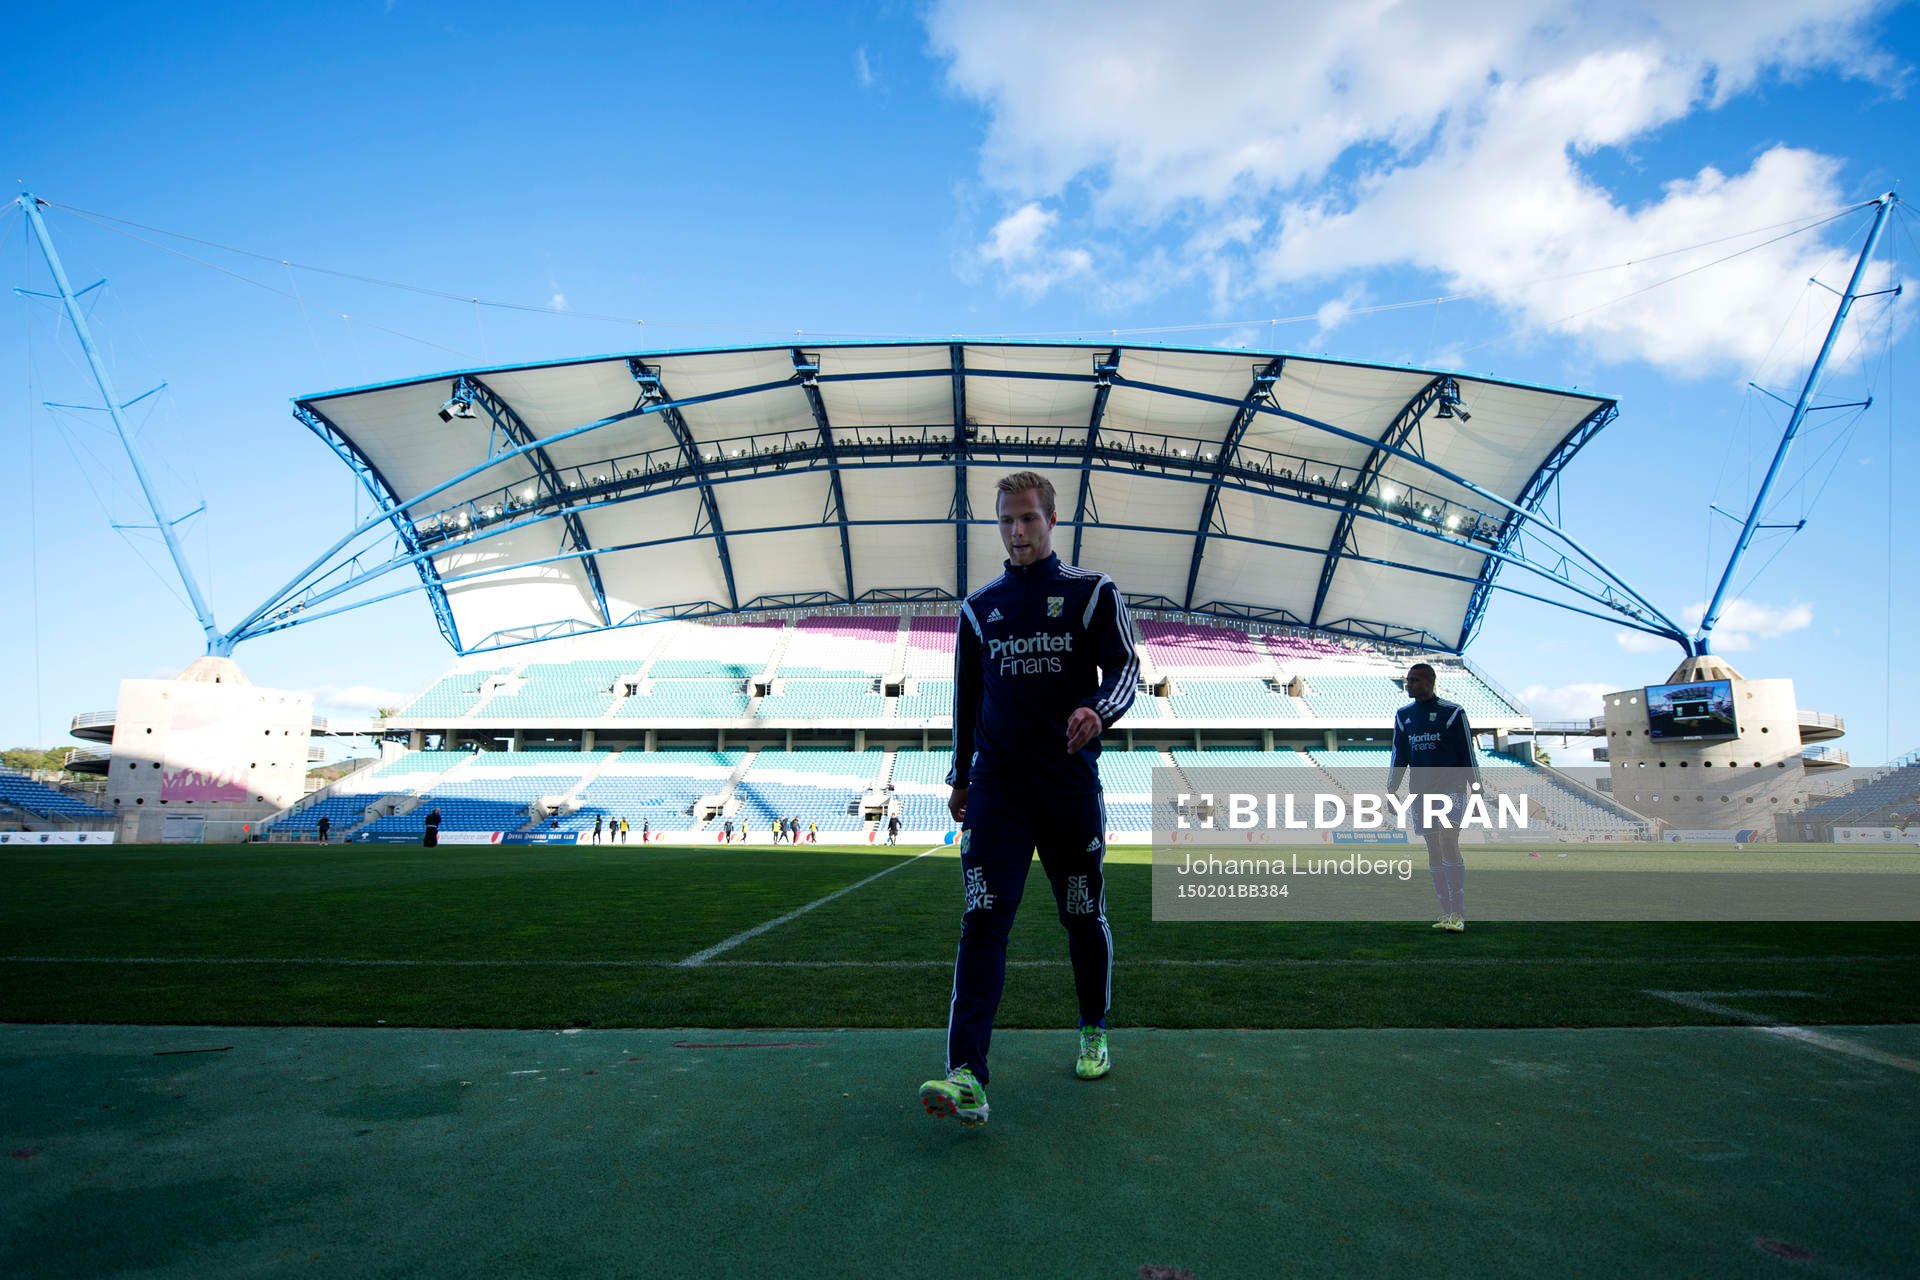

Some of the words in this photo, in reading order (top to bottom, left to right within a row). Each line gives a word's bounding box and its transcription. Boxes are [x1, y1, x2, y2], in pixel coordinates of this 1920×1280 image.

[988, 631, 1072, 660] Prioritet
[1000, 656, 1062, 676] Finans
[1408, 731, 1441, 744] Prioritet
[966, 866, 983, 884] SE
[1067, 874, 1088, 889] SE
[967, 880, 987, 898] RN
[1067, 887, 1088, 902] RN
[1066, 898, 1094, 915] EKE
